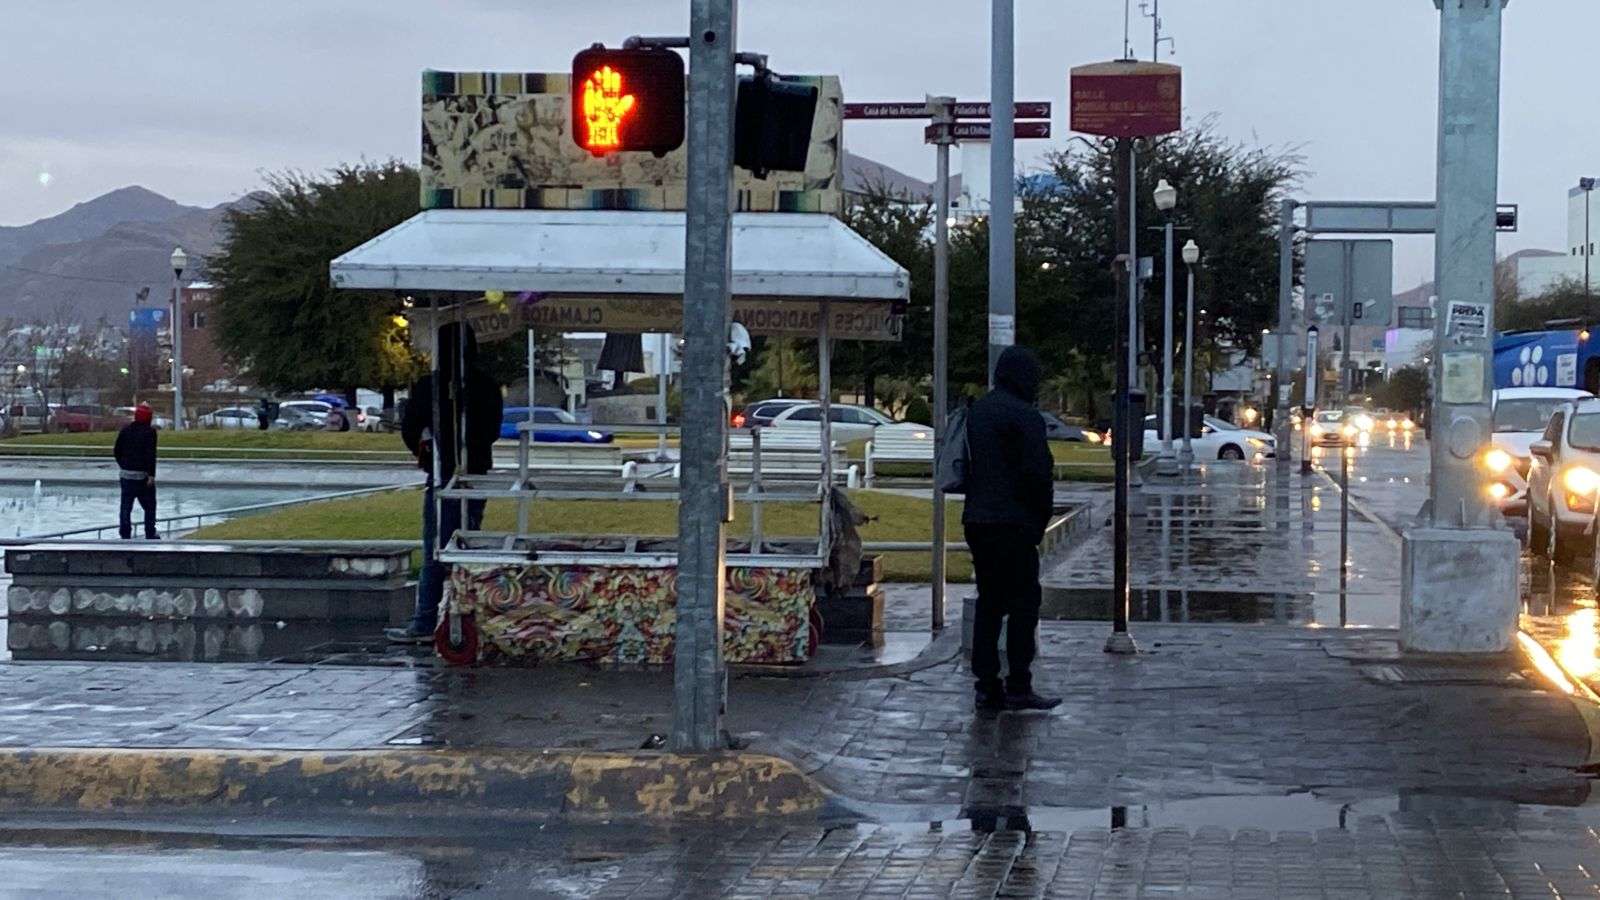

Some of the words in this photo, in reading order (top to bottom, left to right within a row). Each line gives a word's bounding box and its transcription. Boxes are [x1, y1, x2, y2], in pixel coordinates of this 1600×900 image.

[864, 106, 878, 115] Casa
[880, 106, 888, 115] de
[889, 106, 898, 115] las
[954, 105, 976, 115] Palacio
[978, 105, 986, 115] de
[954, 126, 969, 135] Casa
